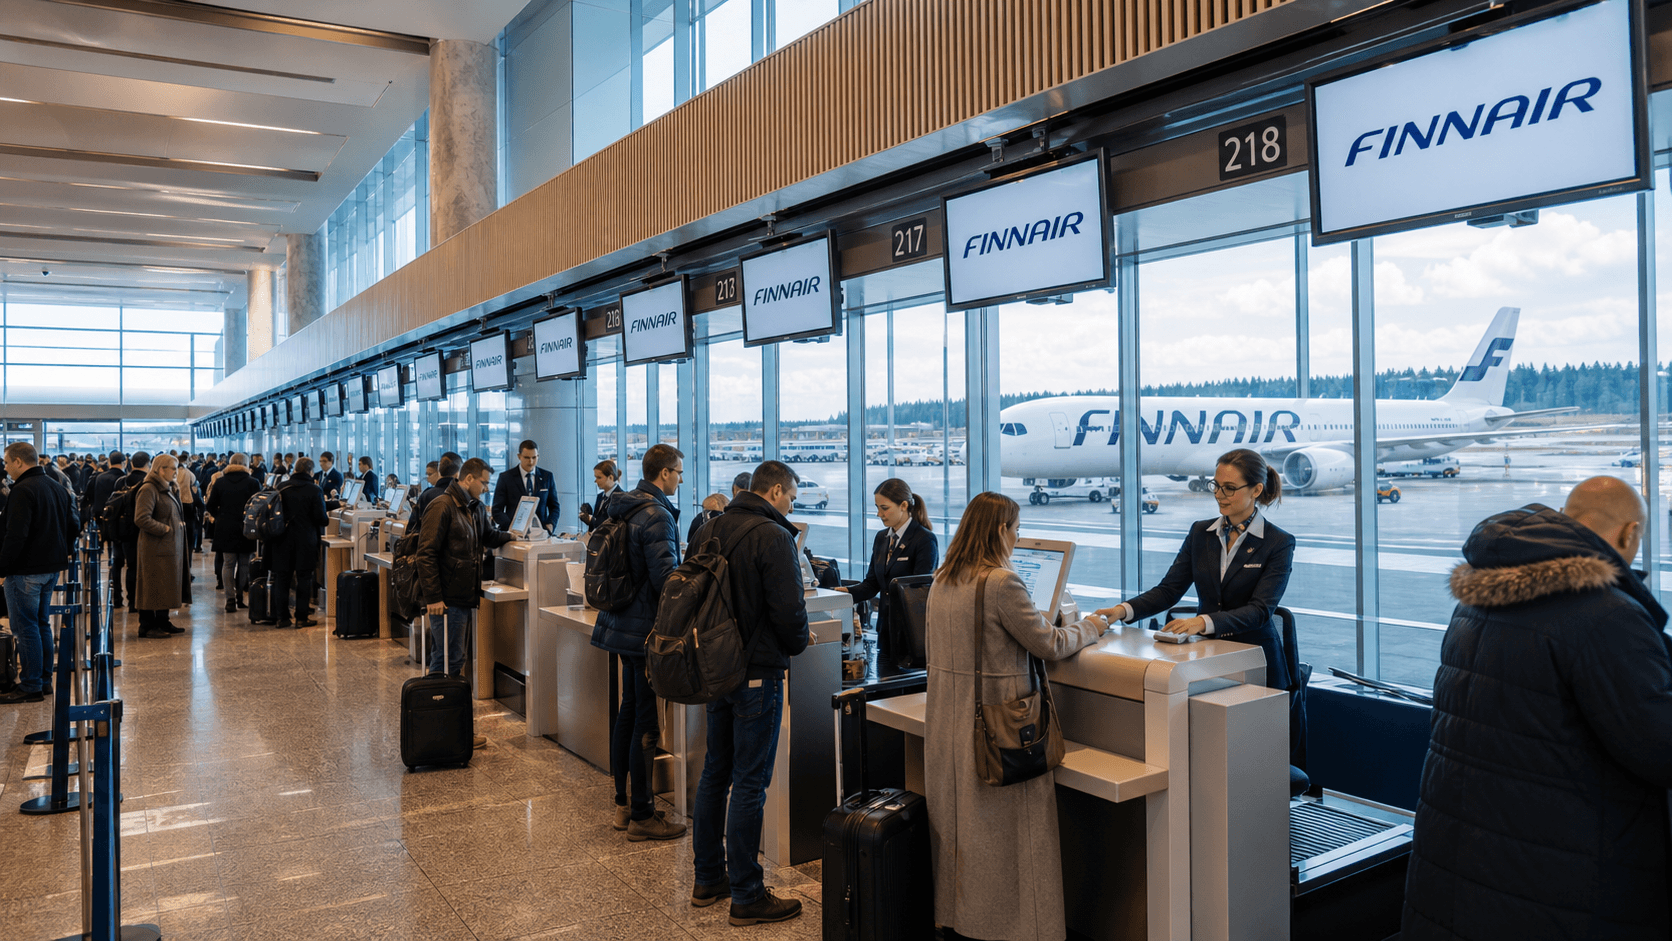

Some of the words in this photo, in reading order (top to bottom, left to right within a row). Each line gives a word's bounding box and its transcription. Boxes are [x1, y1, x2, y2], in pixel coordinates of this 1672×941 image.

[1344, 76, 1602, 167] FINNAIR
[1224, 126, 1281, 173] 218
[894, 224, 924, 257] 217
[963, 211, 1084, 259] FINNAIR
[753, 275, 821, 306] FINNAIR
[630, 311, 677, 334] FINNAIR
[540, 337, 573, 354] FINNAIR
